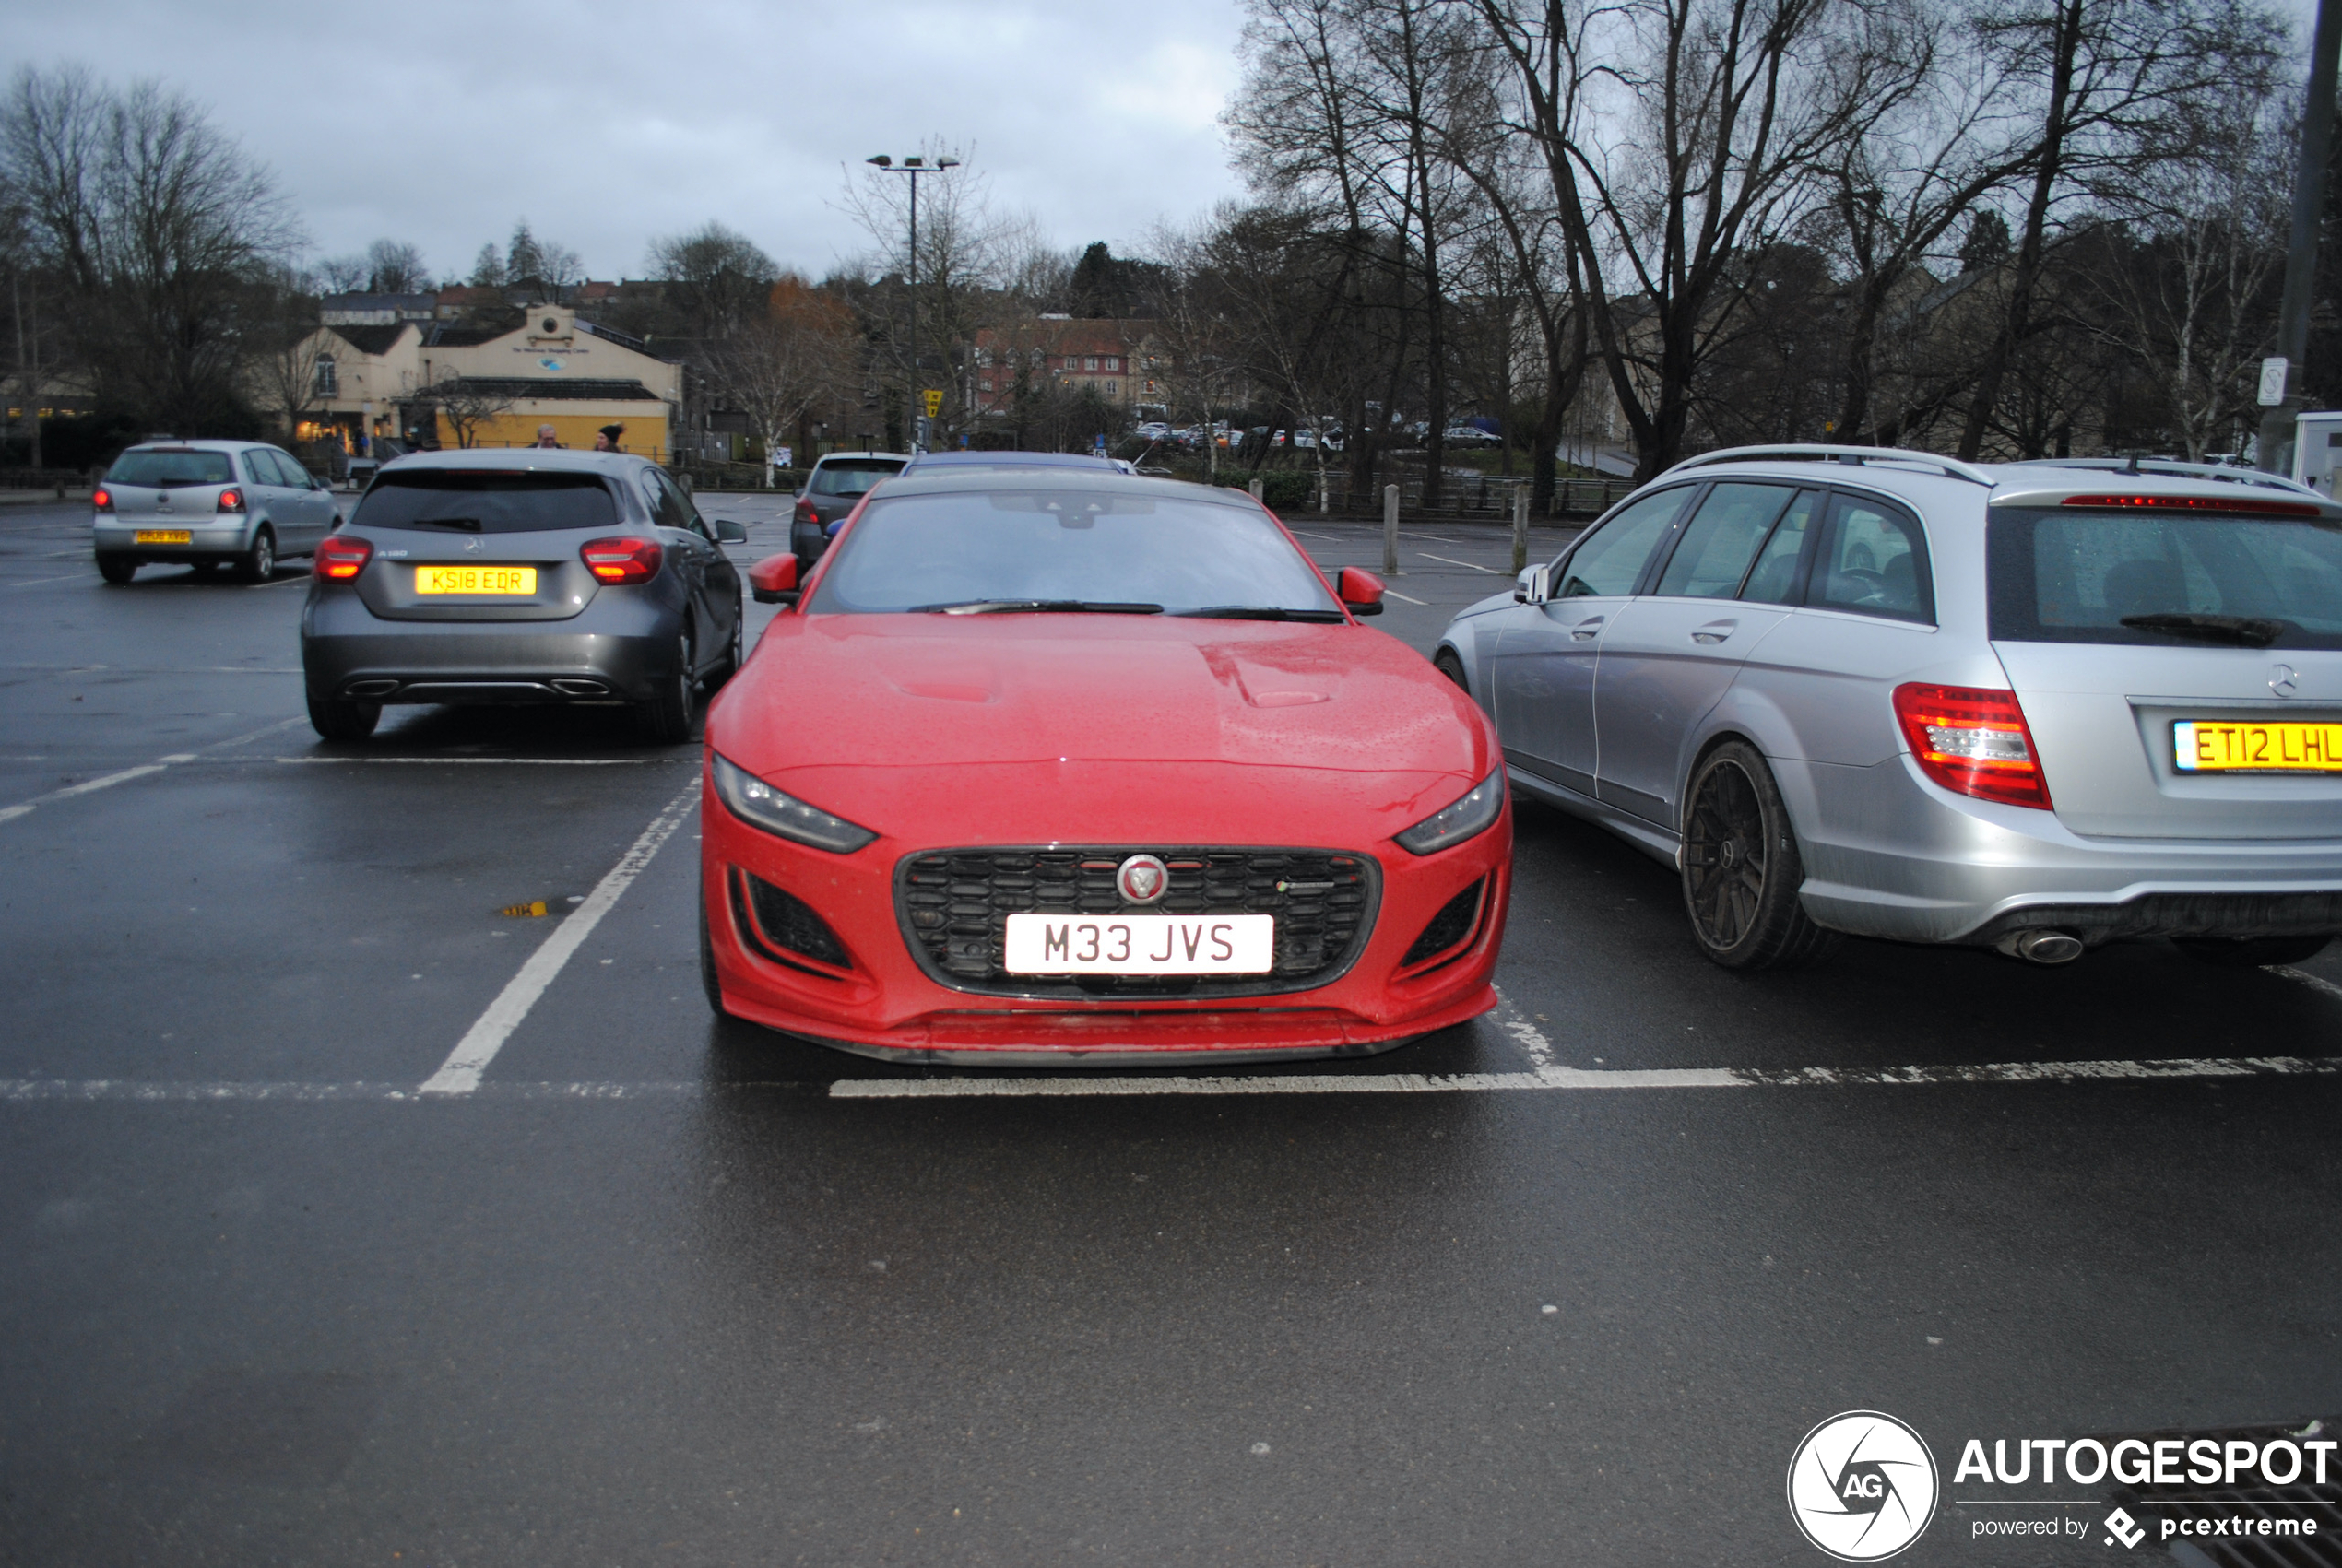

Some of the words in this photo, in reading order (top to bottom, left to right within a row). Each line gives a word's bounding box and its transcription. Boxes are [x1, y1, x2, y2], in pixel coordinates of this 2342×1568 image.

[432, 572, 477, 589] KS18
[2194, 727, 2270, 762] ET12
[2280, 728, 2342, 763] LHL
[1044, 924, 1131, 961] M33
[1149, 924, 1234, 961] JVS
